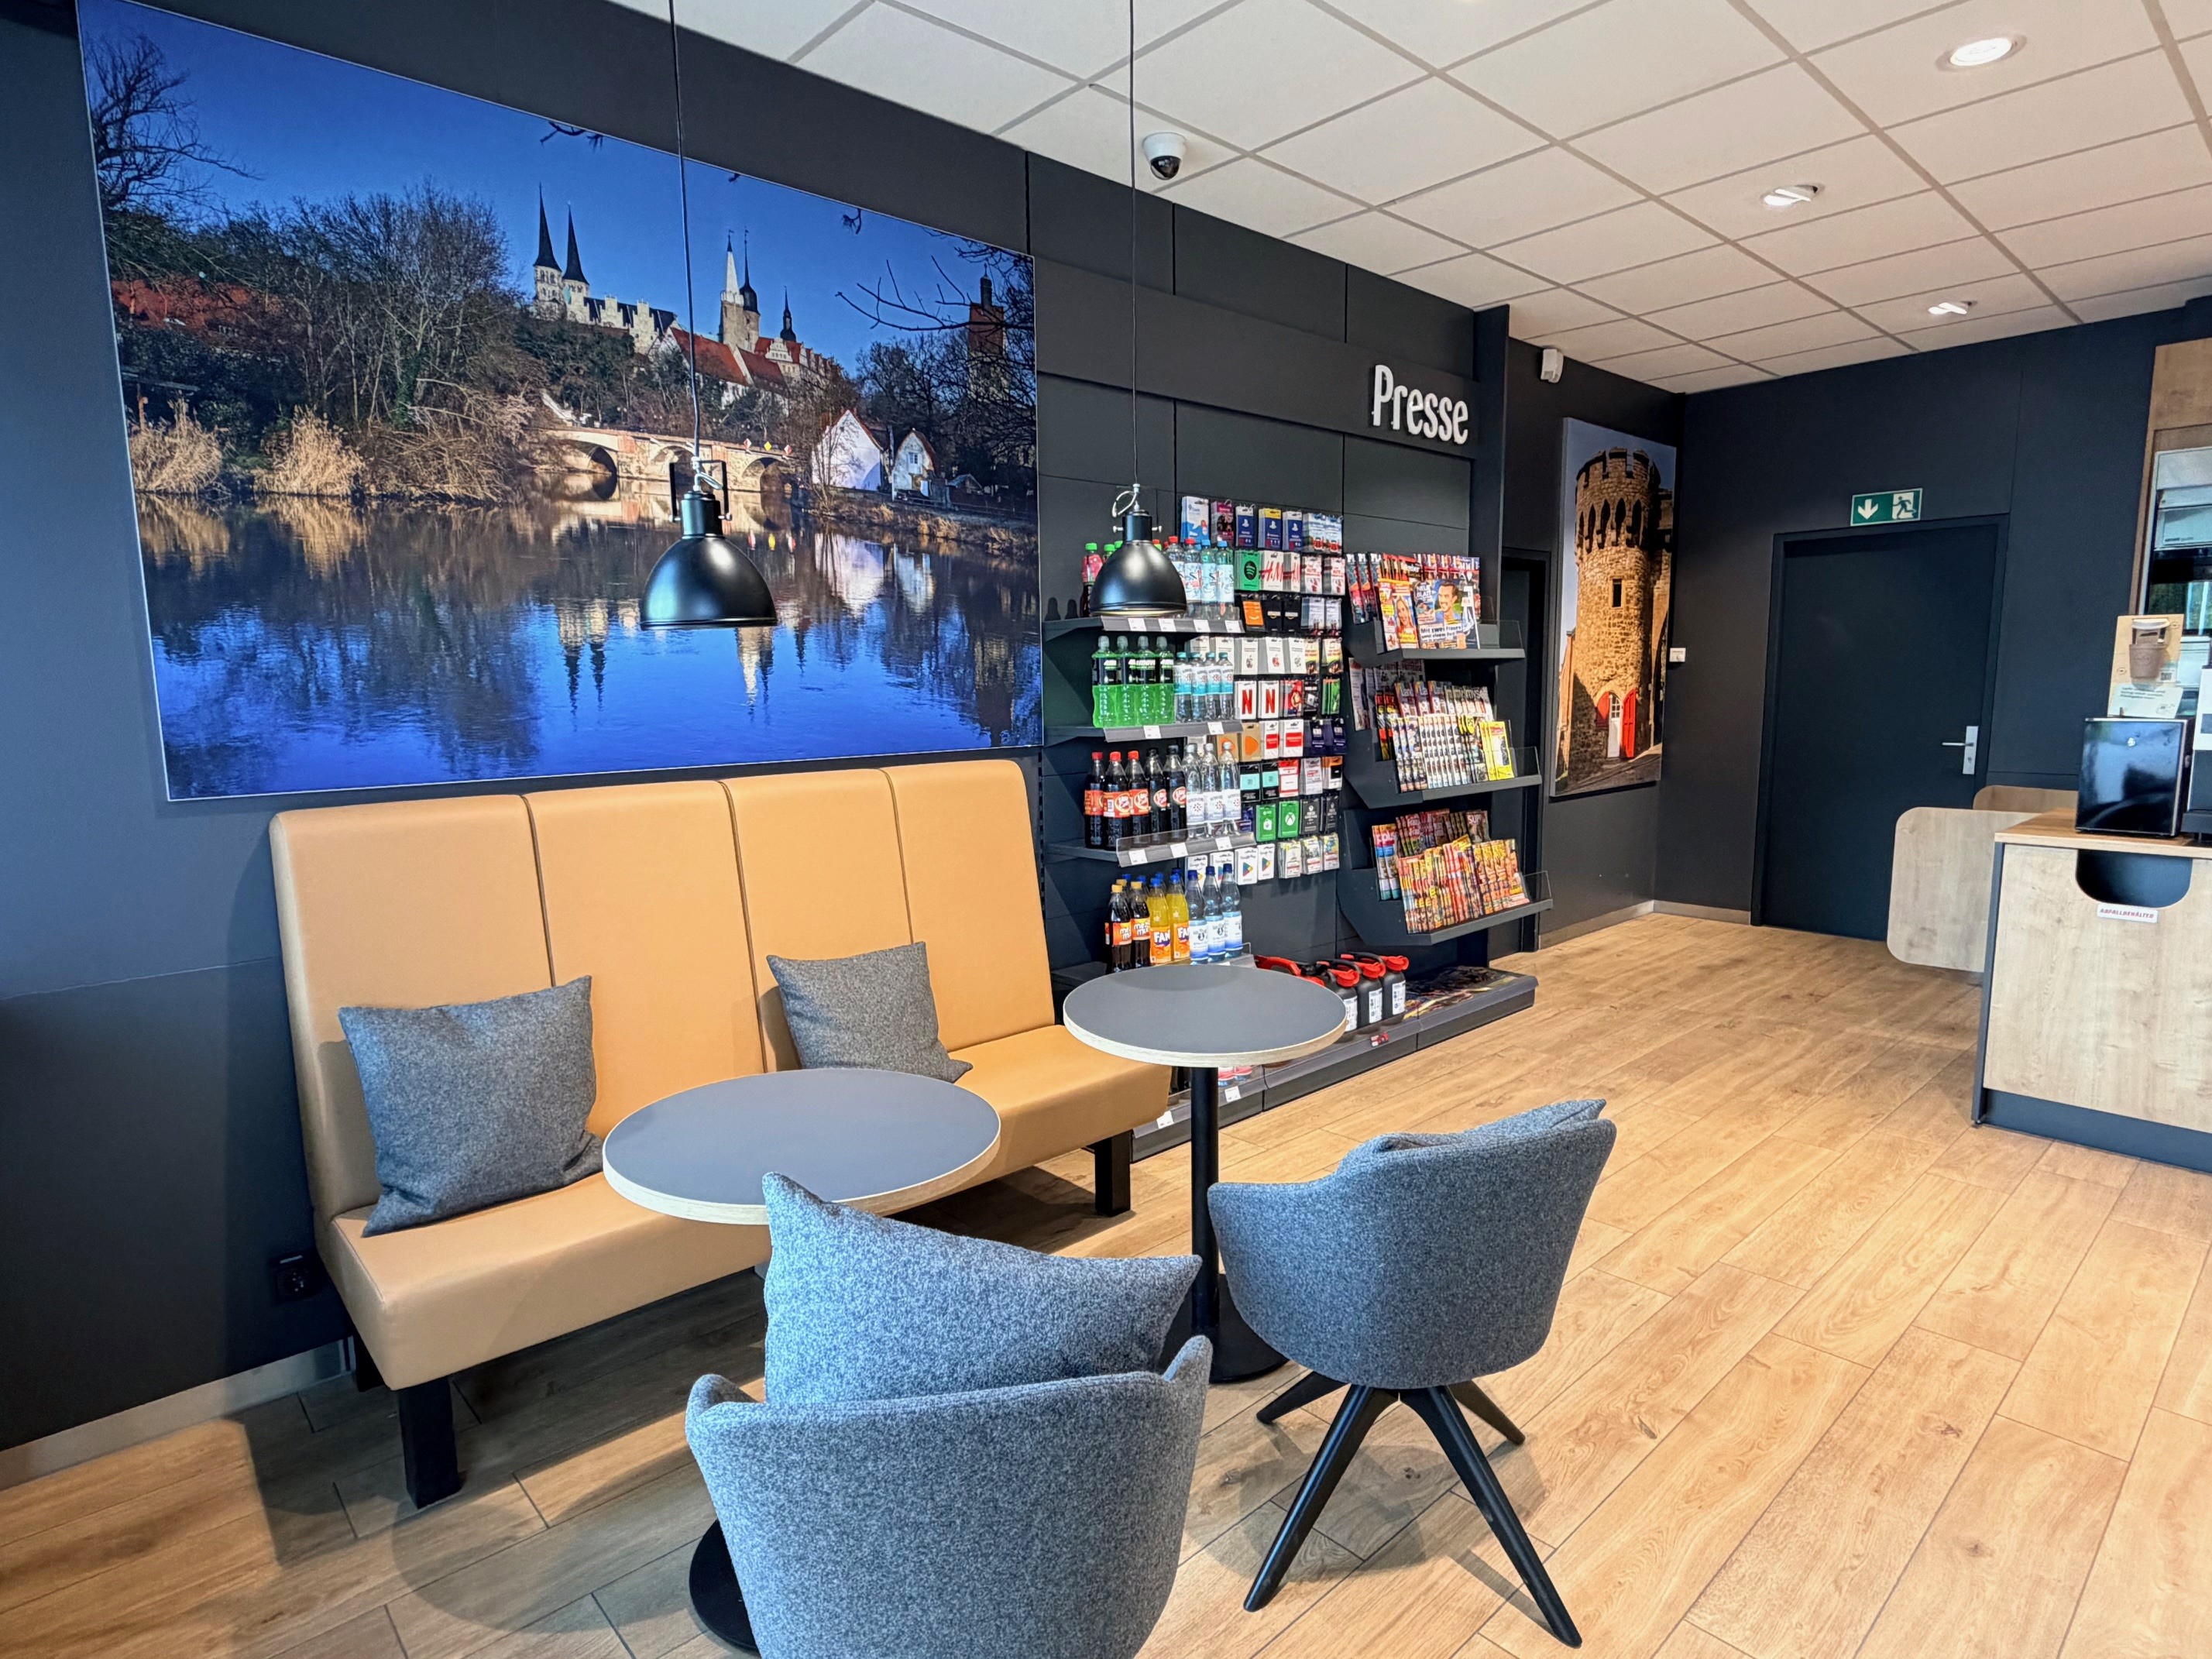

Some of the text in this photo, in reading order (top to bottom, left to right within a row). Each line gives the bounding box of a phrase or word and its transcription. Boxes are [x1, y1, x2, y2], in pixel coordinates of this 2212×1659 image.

[1372, 364, 1469, 445] Presse
[1242, 689, 1253, 714] N
[1265, 689, 1276, 713] N
